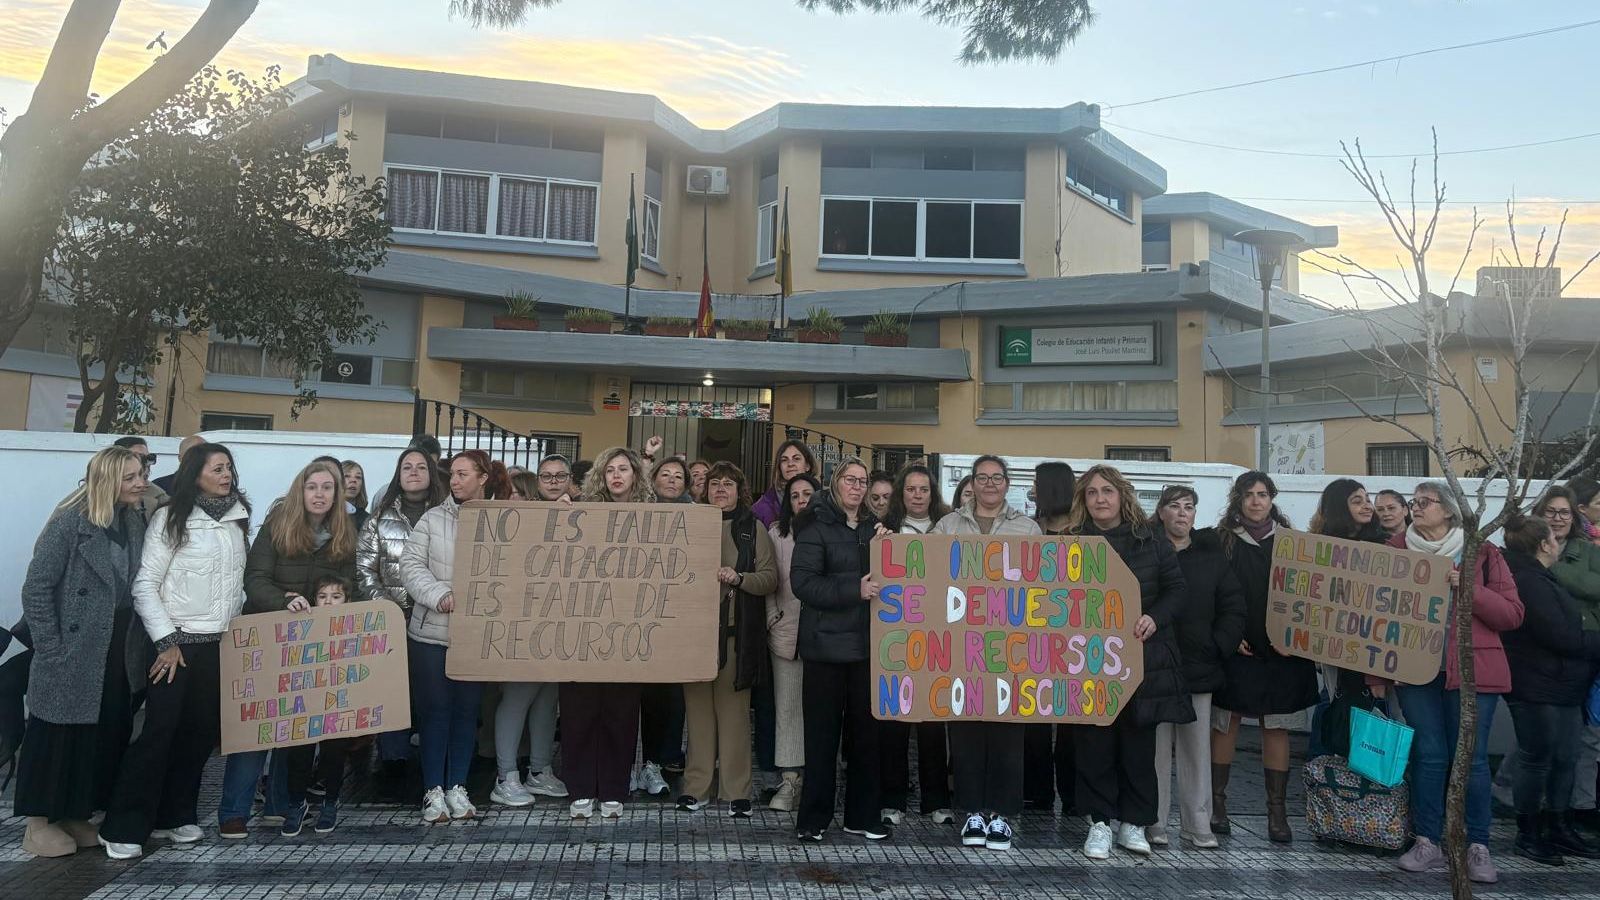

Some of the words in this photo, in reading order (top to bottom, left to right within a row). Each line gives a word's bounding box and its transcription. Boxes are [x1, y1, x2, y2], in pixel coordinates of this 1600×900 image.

[474, 508, 521, 542] NO
[544, 509, 587, 543] ES
[605, 510, 689, 545] FALTA
[471, 544, 512, 576] DE
[524, 545, 696, 584] CAPACIDAD,
[881, 539, 926, 579] LA
[1276, 535, 1431, 584] ALUMNADO
[465, 581, 506, 617] ES
[522, 581, 615, 618] FALTA
[634, 583, 680, 618] DE
[878, 585, 926, 623] SE
[947, 586, 1124, 629] DEMUESTRA
[1272, 566, 1324, 599] NEAE
[1329, 576, 1444, 623] INVISIBLE
[233, 627, 260, 648] LA
[275, 618, 314, 643] LEY
[329, 611, 386, 636] HABLA
[481, 620, 663, 661] RECURSOS
[1335, 608, 1443, 654] EDUCATIVO
[243, 650, 263, 672] DE
[879, 629, 951, 672] CON
[965, 631, 1131, 681] RECURSOS,
[232, 678, 255, 700] LA
[278, 664, 370, 693] REALIDAD
[880, 674, 914, 716] NO
[929, 675, 984, 716] CON
[997, 673, 1123, 717] DISCURSOS
[241, 695, 306, 722] HABLA
[325, 688, 348, 711] DE
[258, 705, 383, 744] RECORTES
